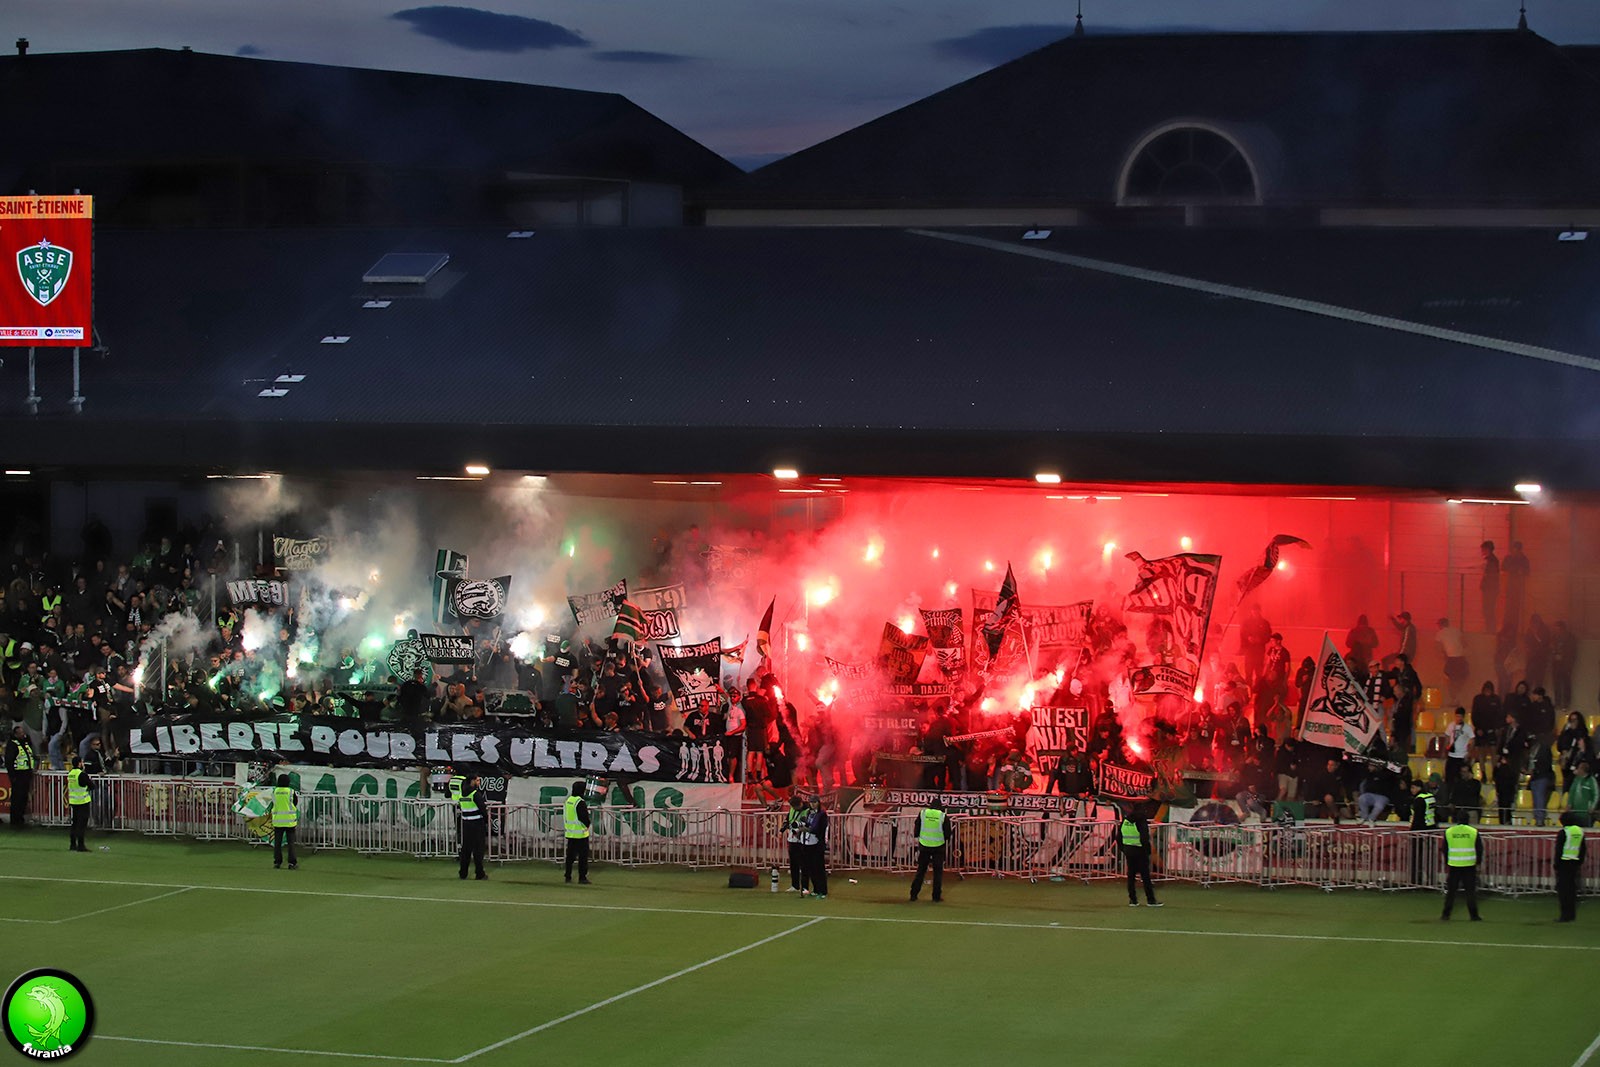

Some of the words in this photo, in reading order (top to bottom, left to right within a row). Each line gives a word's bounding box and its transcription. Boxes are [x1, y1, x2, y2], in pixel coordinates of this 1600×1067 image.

[0, 200, 84, 214] SAINT-ÉTIENNE
[24, 252, 66, 266] ASSE
[274, 537, 320, 558] Magic
[424, 637, 461, 649] ULTRAS
[660, 644, 693, 658] MAGIC
[694, 641, 720, 657] FANS
[1032, 708, 1051, 726] ON
[1056, 708, 1084, 727] EST
[130, 722, 304, 754] LIBERTE
[311, 726, 418, 759] POUR
[425, 733, 500, 764] LES
[510, 737, 660, 774] ULTRAS
[478, 776, 505, 792] VEC
[1106, 766, 1153, 787] PARTOUT
[902, 792, 933, 806] FOOT
[539, 786, 687, 837] FNS
